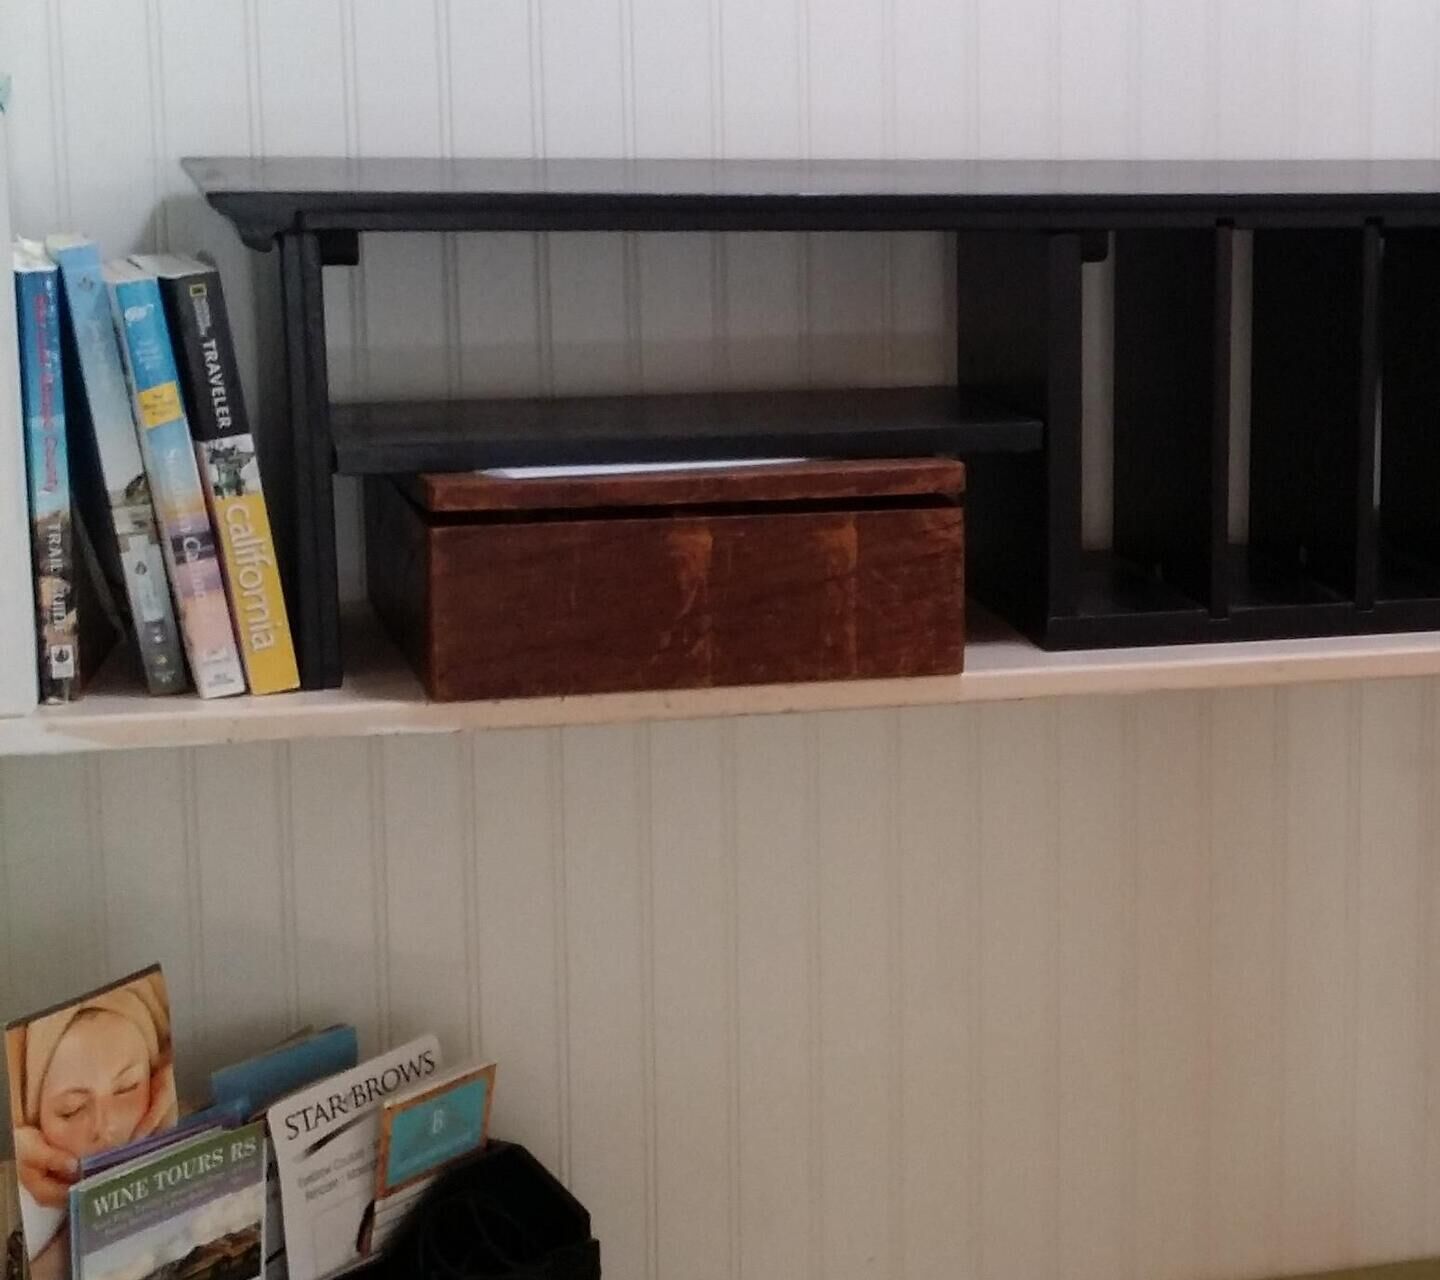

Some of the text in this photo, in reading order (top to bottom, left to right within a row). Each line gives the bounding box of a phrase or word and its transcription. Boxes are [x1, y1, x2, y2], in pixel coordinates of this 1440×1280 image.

[202, 338, 232, 430] TRAVELER
[47, 524, 64, 573] TRAIL
[226, 504, 275, 650] california
[284, 1050, 435, 1140] STAR BROWS
[94, 1176, 149, 1216] WINE
[153, 1147, 224, 1190] TOURS
